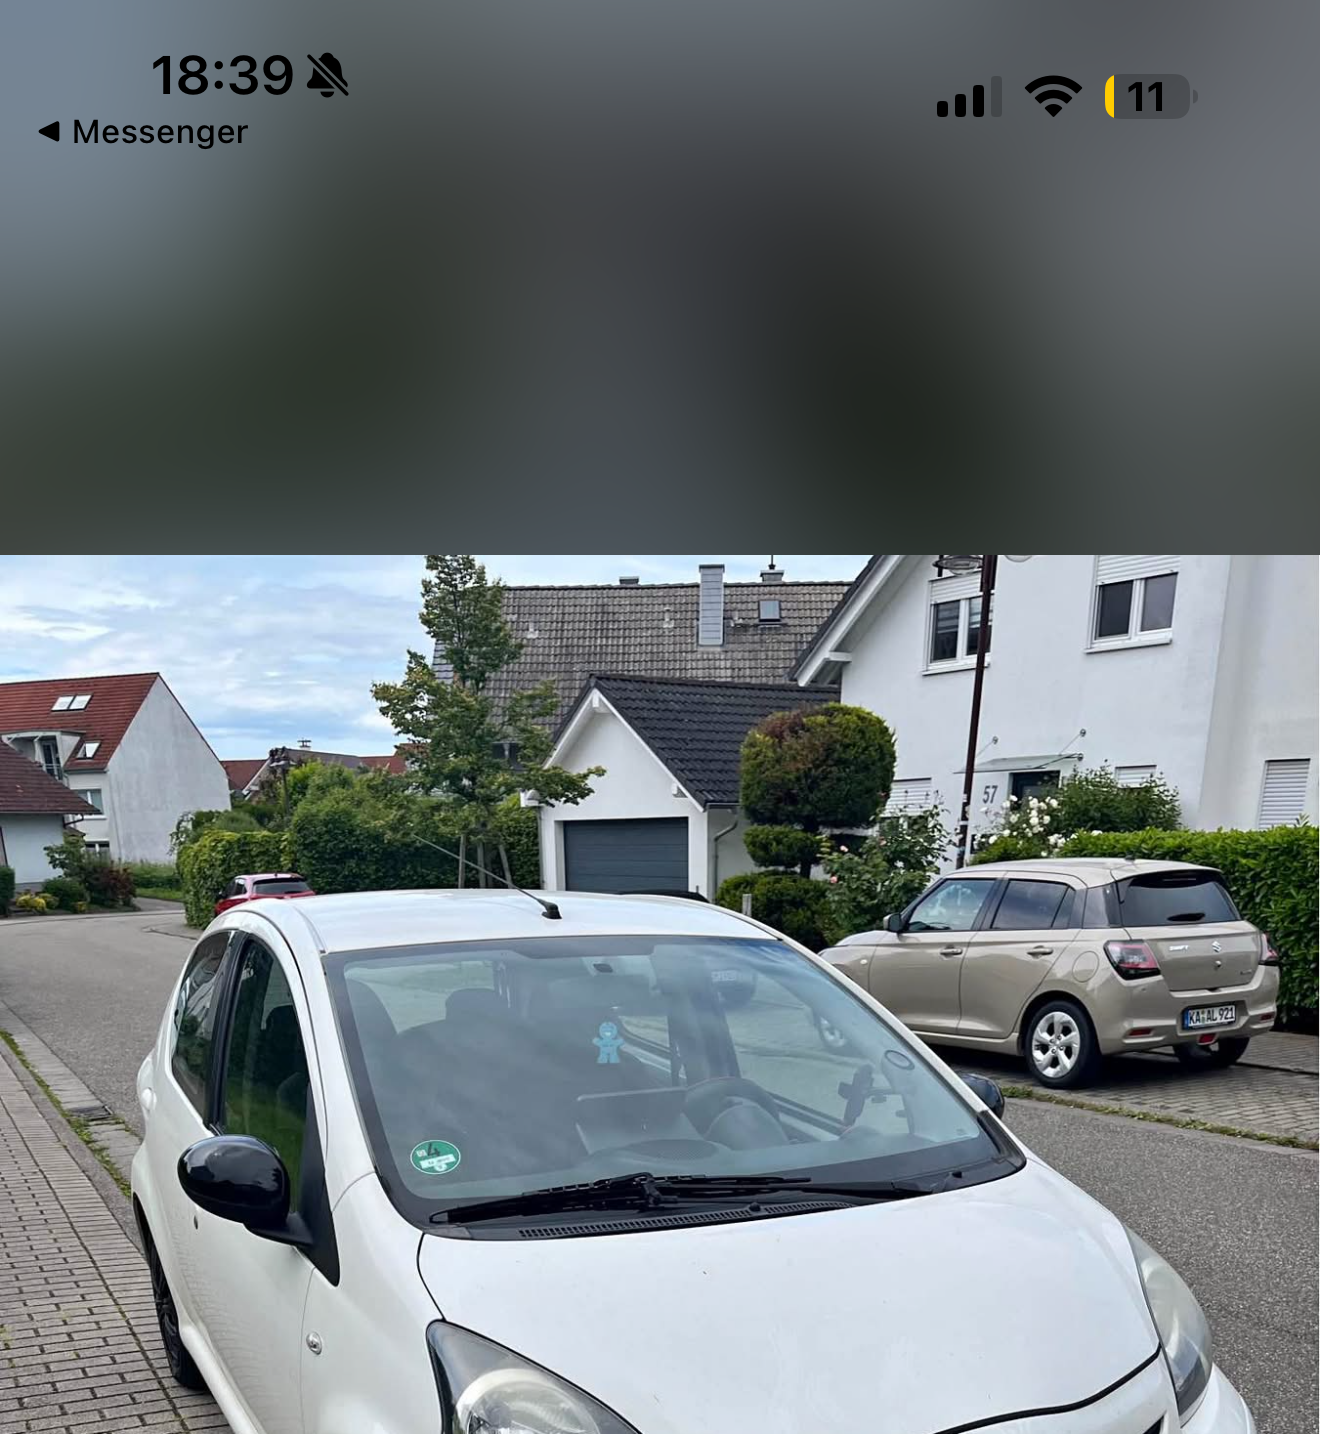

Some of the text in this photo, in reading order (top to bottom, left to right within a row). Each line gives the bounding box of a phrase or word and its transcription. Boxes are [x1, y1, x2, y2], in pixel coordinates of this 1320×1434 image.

[982, 785, 998, 804] 57
[1189, 1006, 1235, 1025] KA AL 921
[427, 1142, 440, 1157] 4
